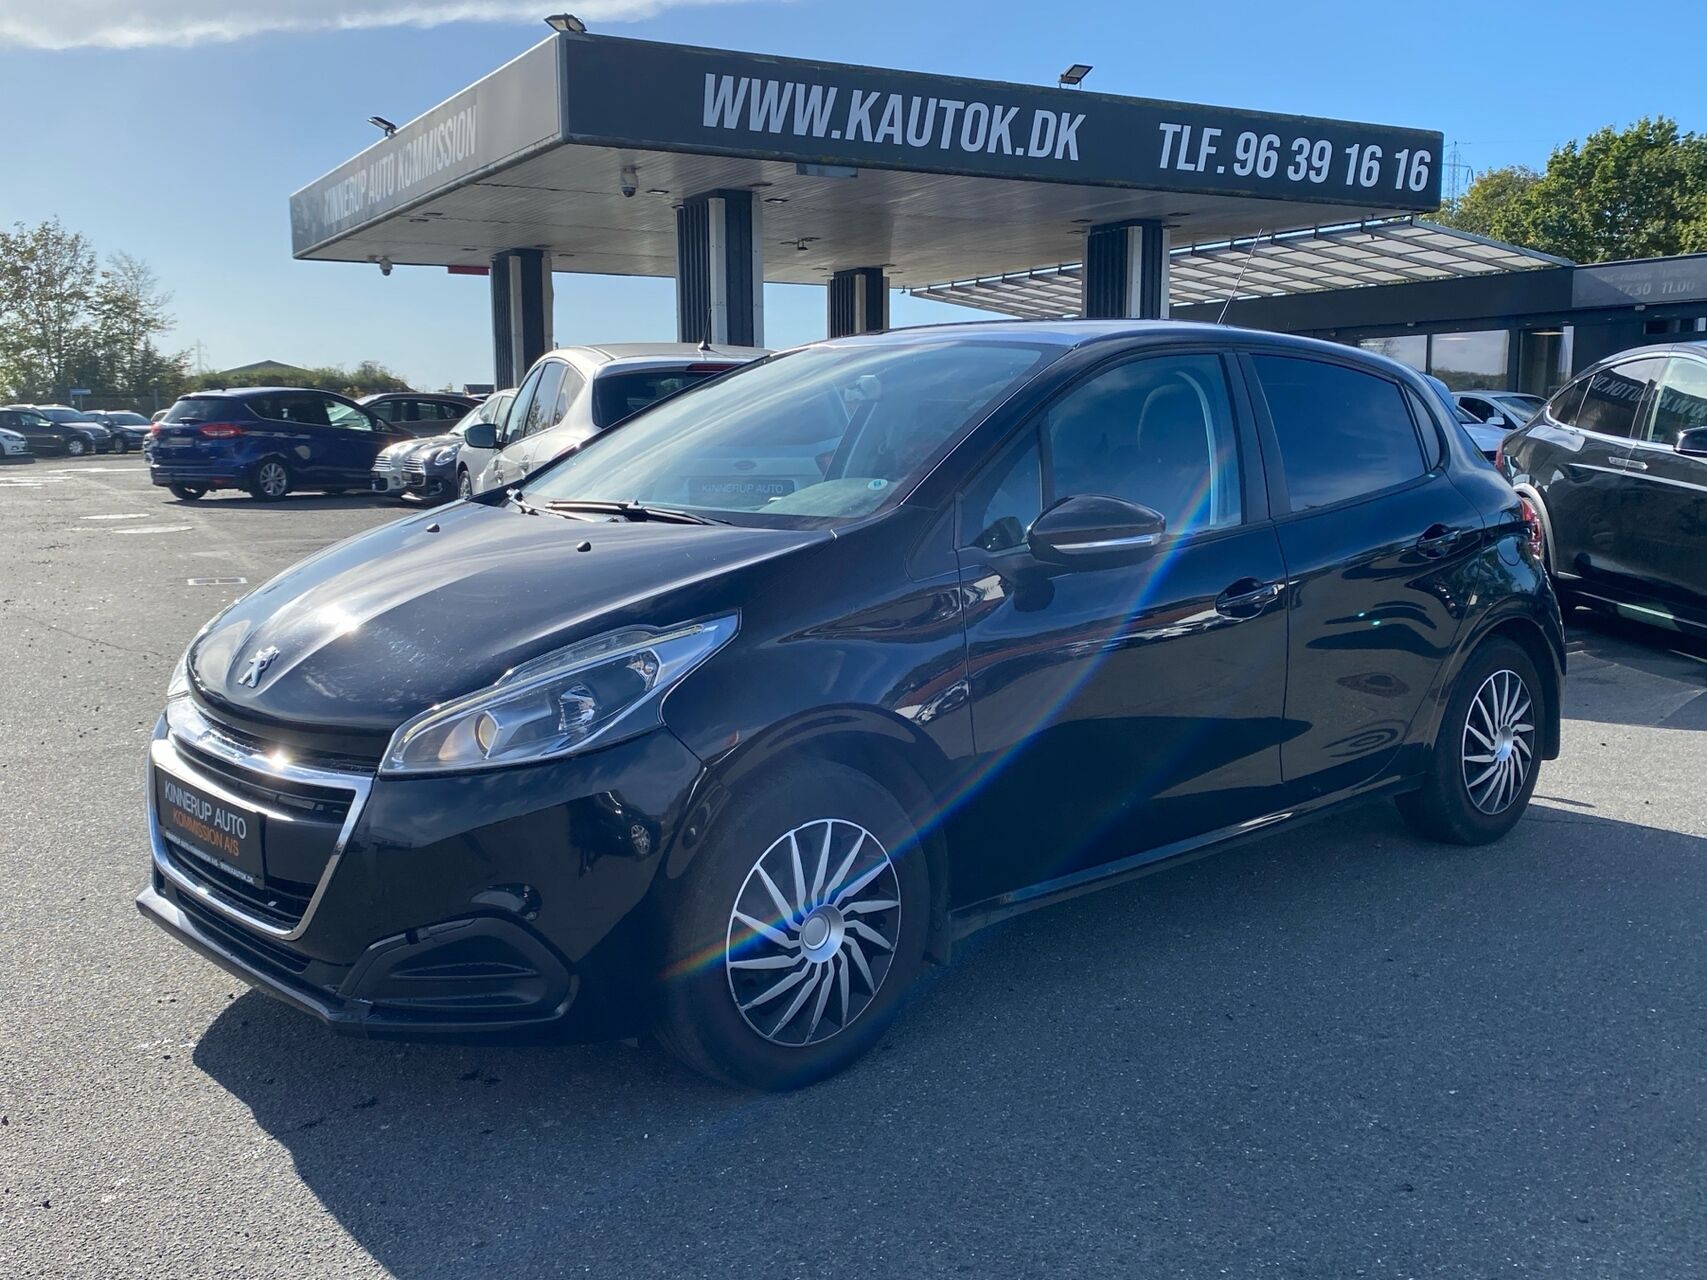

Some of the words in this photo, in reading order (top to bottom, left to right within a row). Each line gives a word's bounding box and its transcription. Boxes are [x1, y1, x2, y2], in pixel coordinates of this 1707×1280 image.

[702, 73, 1086, 162] WWW.KAUTOK.DK
[324, 171, 367, 226] KINNERUP
[368, 153, 395, 204] AUTO
[398, 107, 476, 190] KOMMISSION
[1157, 122, 1225, 177] TLF.
[1234, 131, 1279, 179] 96
[1286, 137, 1331, 184] 39
[1344, 142, 1381, 188] 16
[1393, 147, 1431, 193] 16
[703, 483, 754, 494] KINNERUP
[756, 483, 783, 494] AUTO
[165, 781, 212, 822] KINNERUP
[214, 807, 247, 840] AUTO
[173, 809, 223, 848] KOMMISSION
[224, 836, 239, 857] A/S
